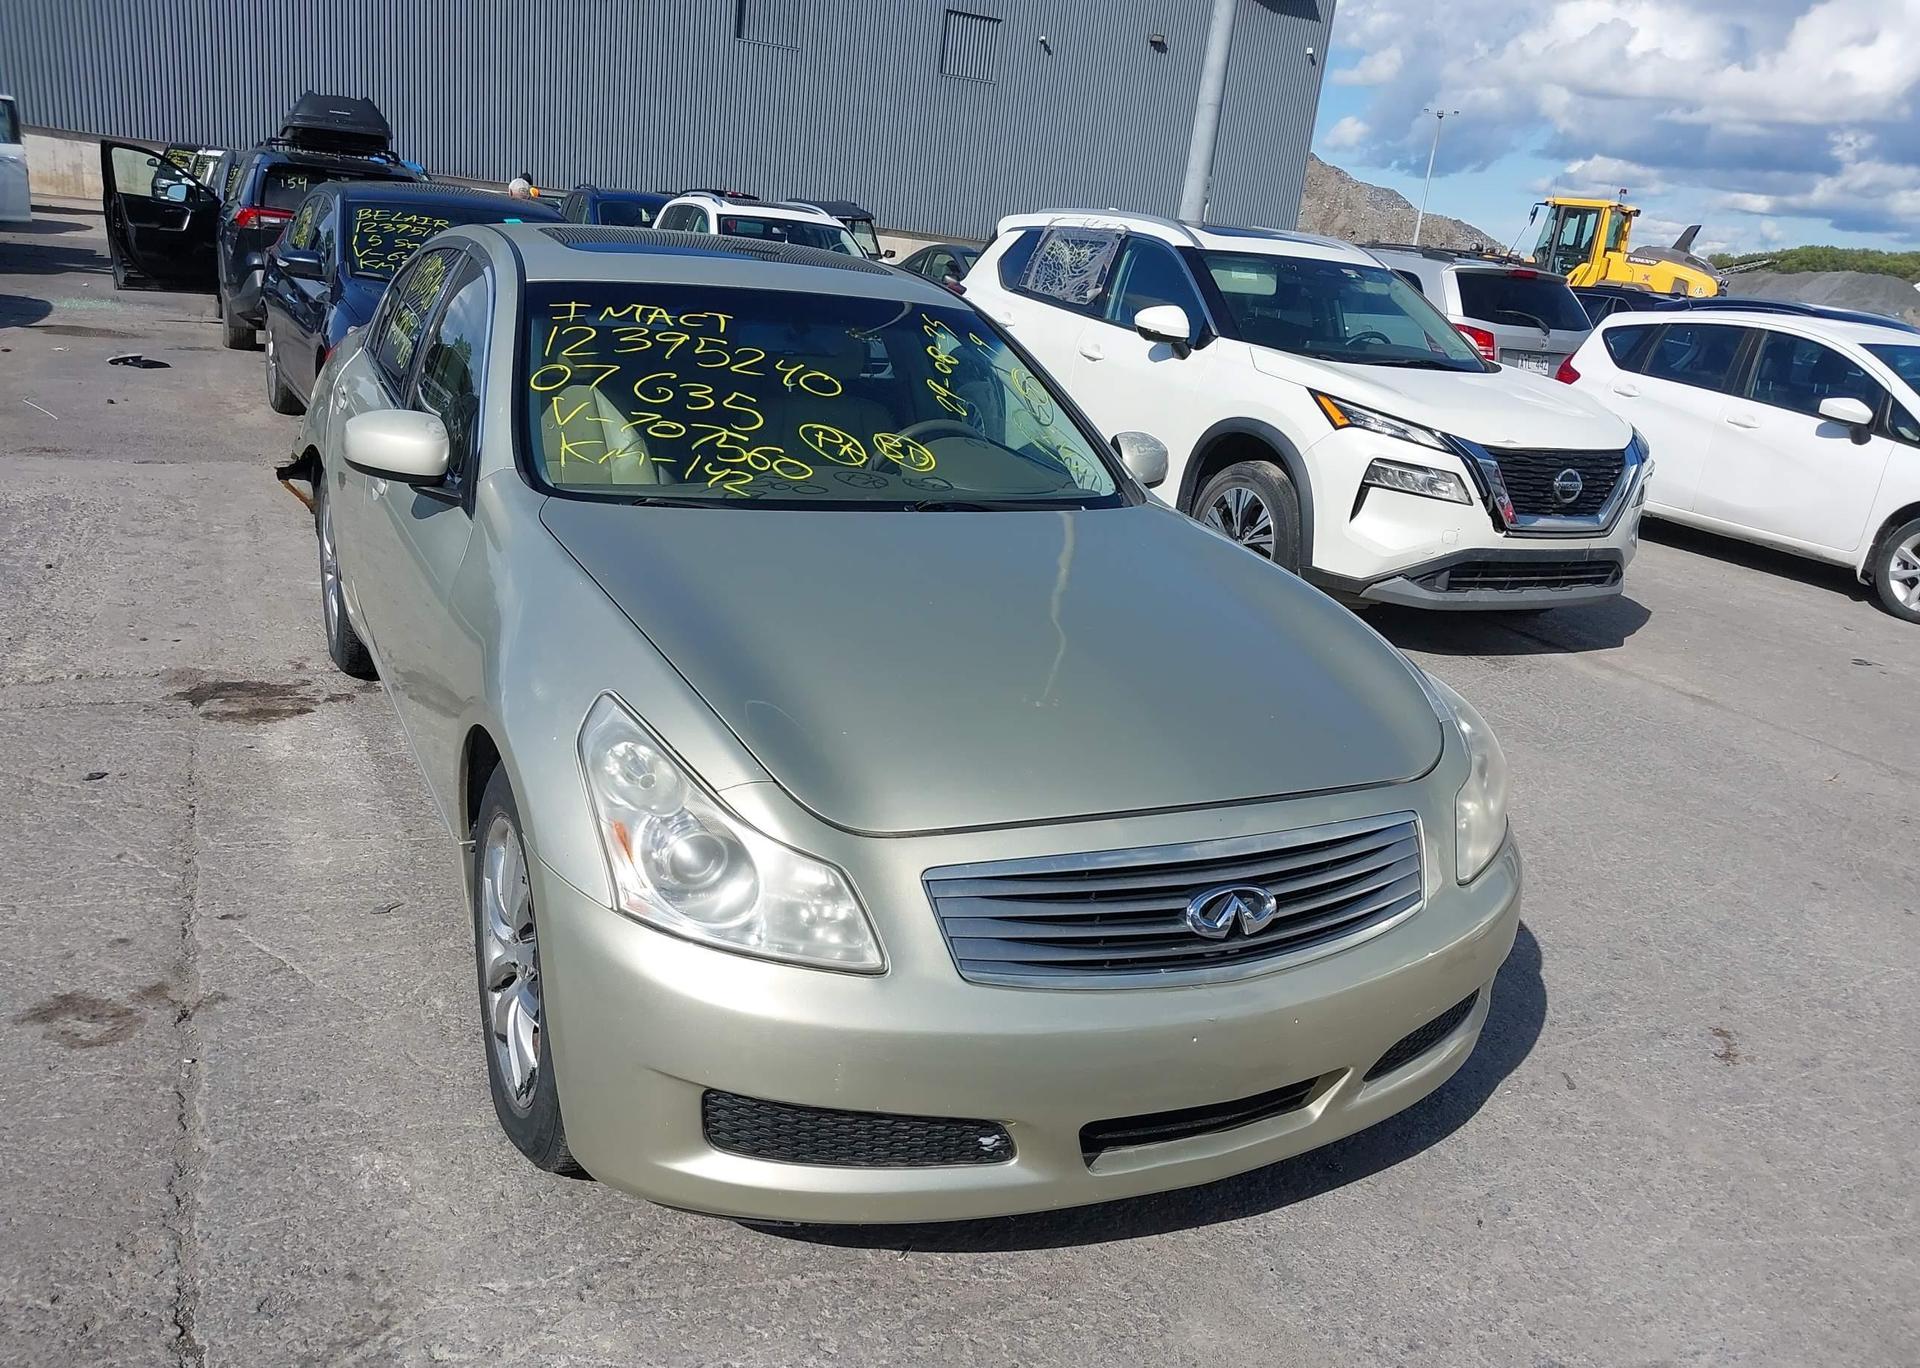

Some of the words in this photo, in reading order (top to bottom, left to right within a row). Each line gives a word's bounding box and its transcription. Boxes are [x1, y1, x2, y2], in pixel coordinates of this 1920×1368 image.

[281, 177, 308, 192] 154
[356, 208, 450, 230] BELAIR
[356, 221, 438, 237] 123951
[549, 301, 733, 333] INTACT
[544, 326, 842, 397] 12395240
[530, 363, 621, 391] 07
[633, 373, 764, 430] G35
